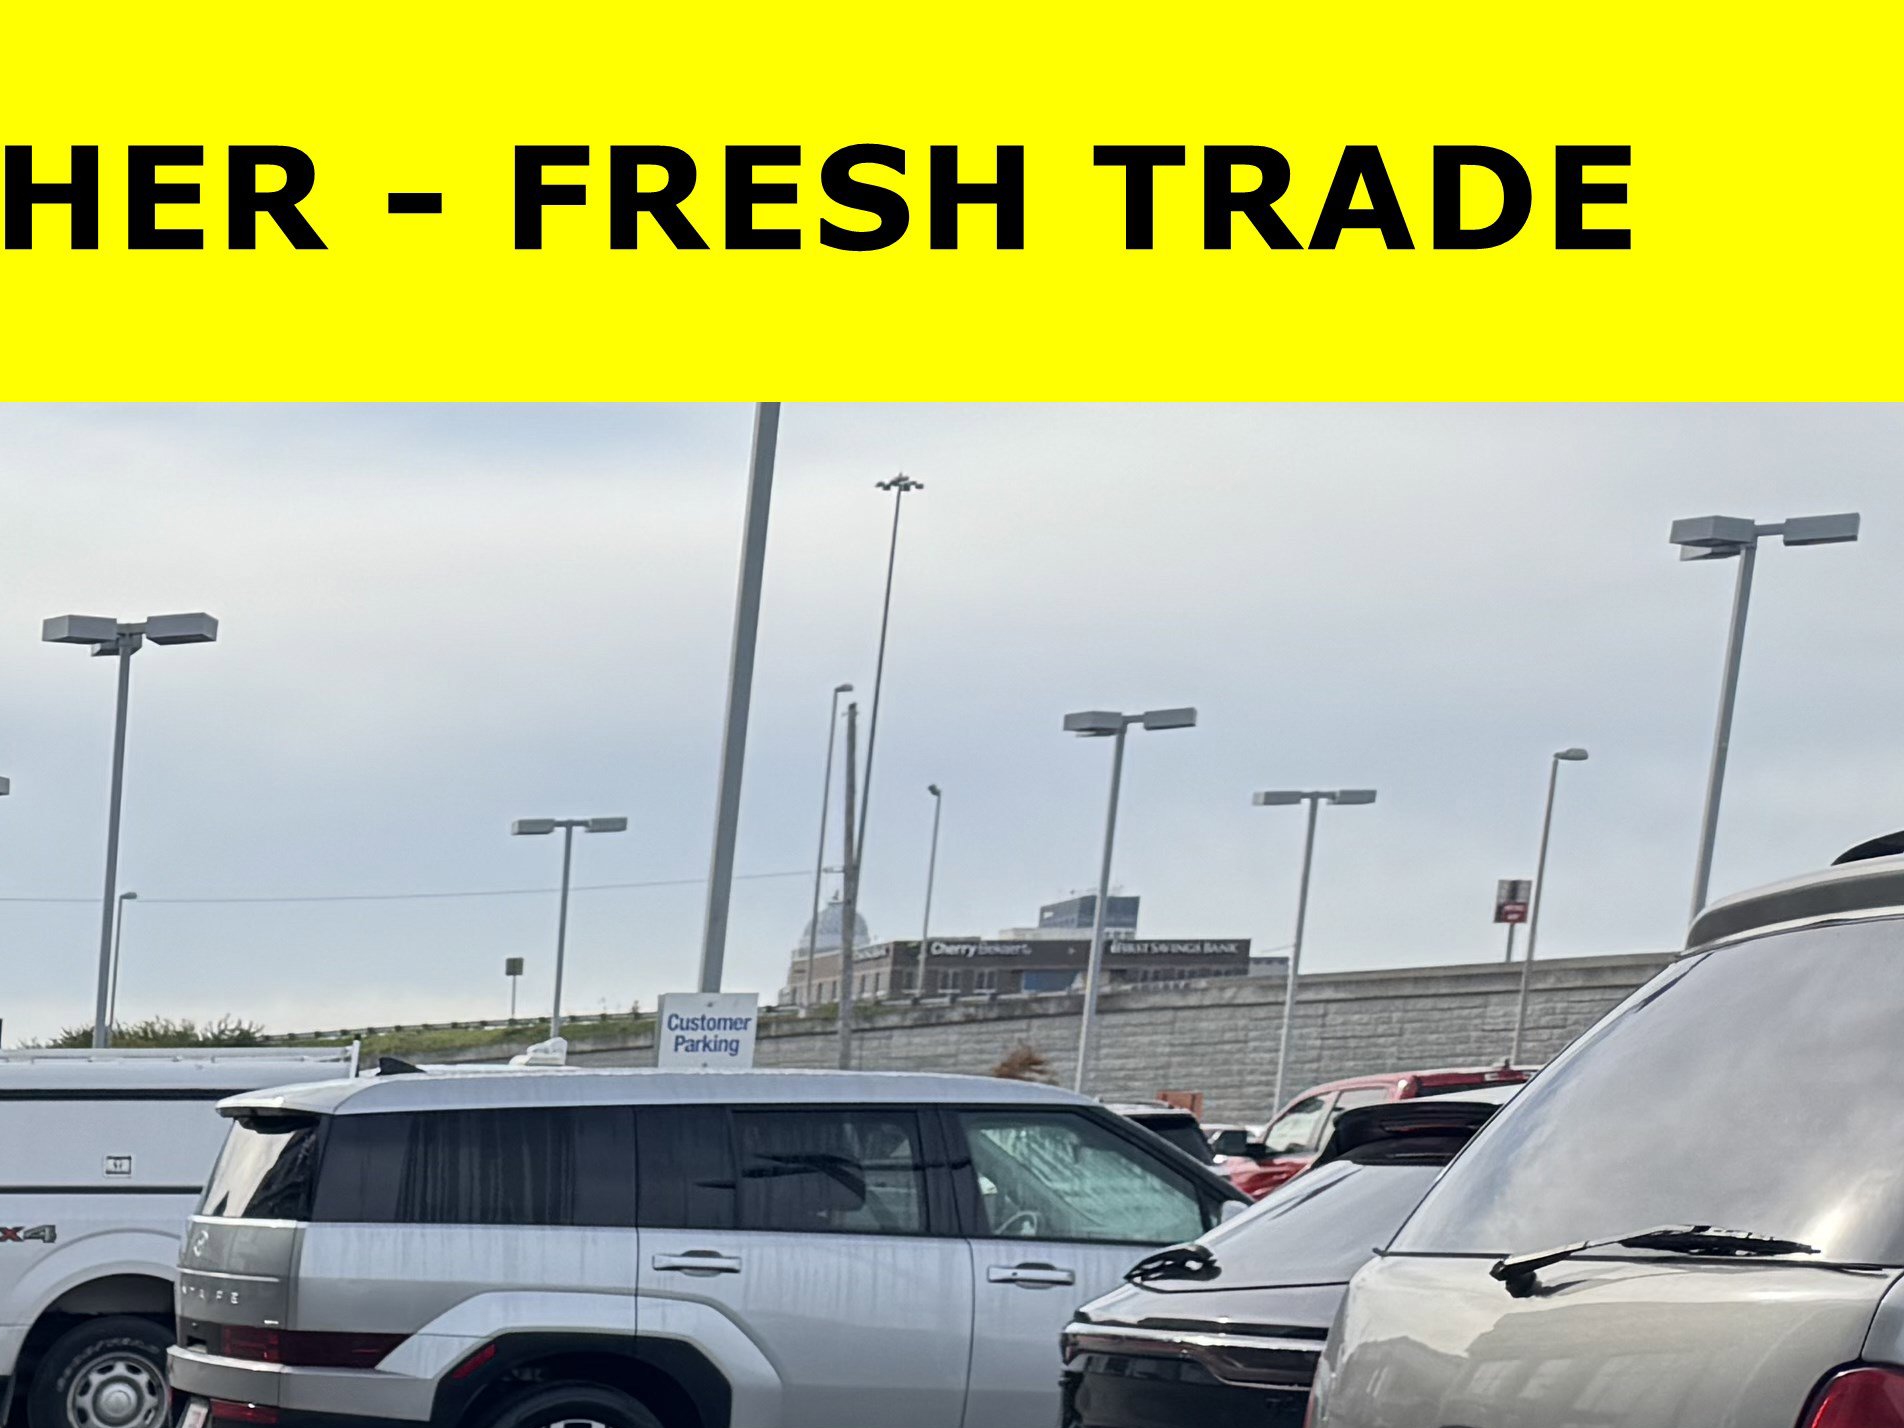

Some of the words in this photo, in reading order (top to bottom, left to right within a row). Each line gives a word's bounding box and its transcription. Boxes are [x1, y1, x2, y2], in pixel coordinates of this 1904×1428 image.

[930, 941, 978, 958] Cherry
[1203, 942, 1238, 954] BANK
[667, 1013, 752, 1032] Customer
[673, 1034, 740, 1057] Parking
